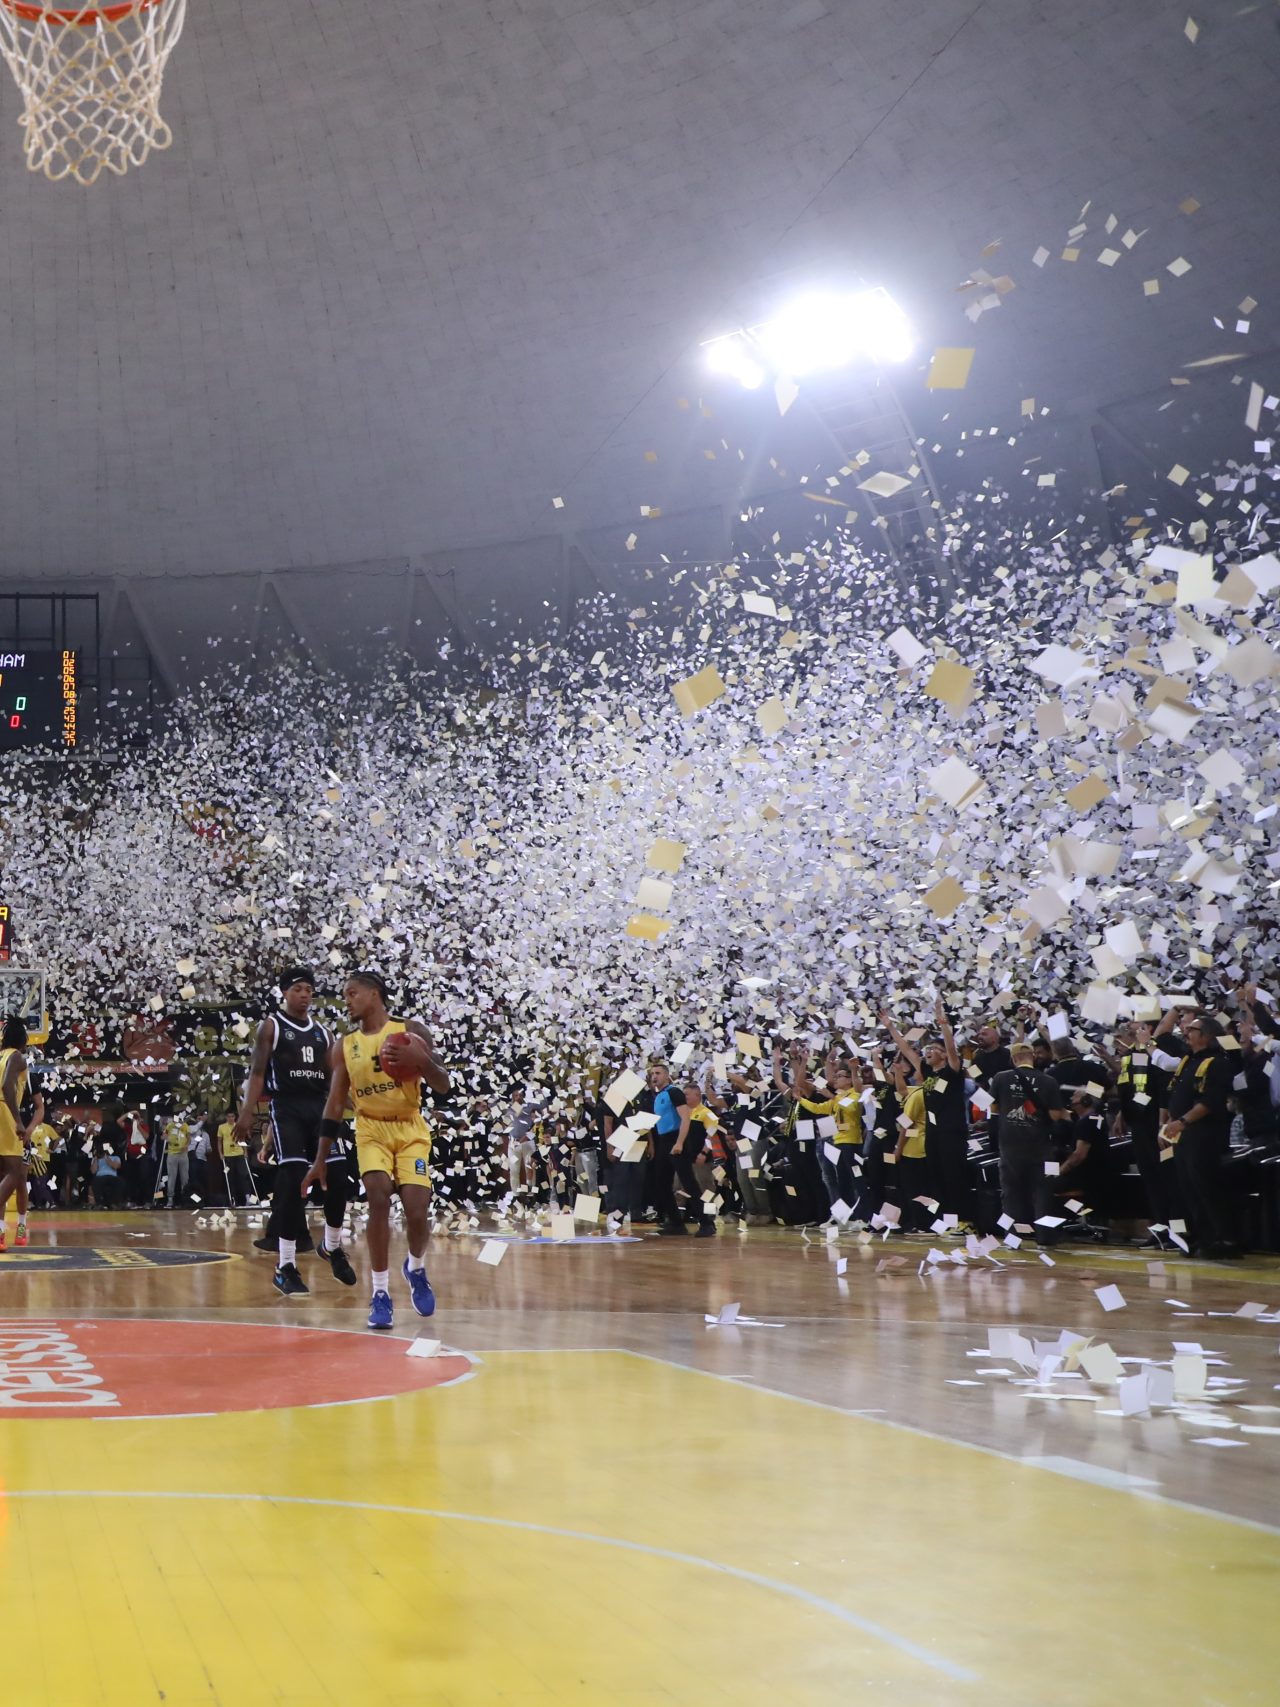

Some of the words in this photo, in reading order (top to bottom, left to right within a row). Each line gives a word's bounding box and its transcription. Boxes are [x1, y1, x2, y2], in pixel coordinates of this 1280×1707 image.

[15, 697, 26, 711] 0
[10, 715, 20, 728] 0
[301, 1046, 314, 1063] 19
[356, 1081, 402, 1097] betsso
